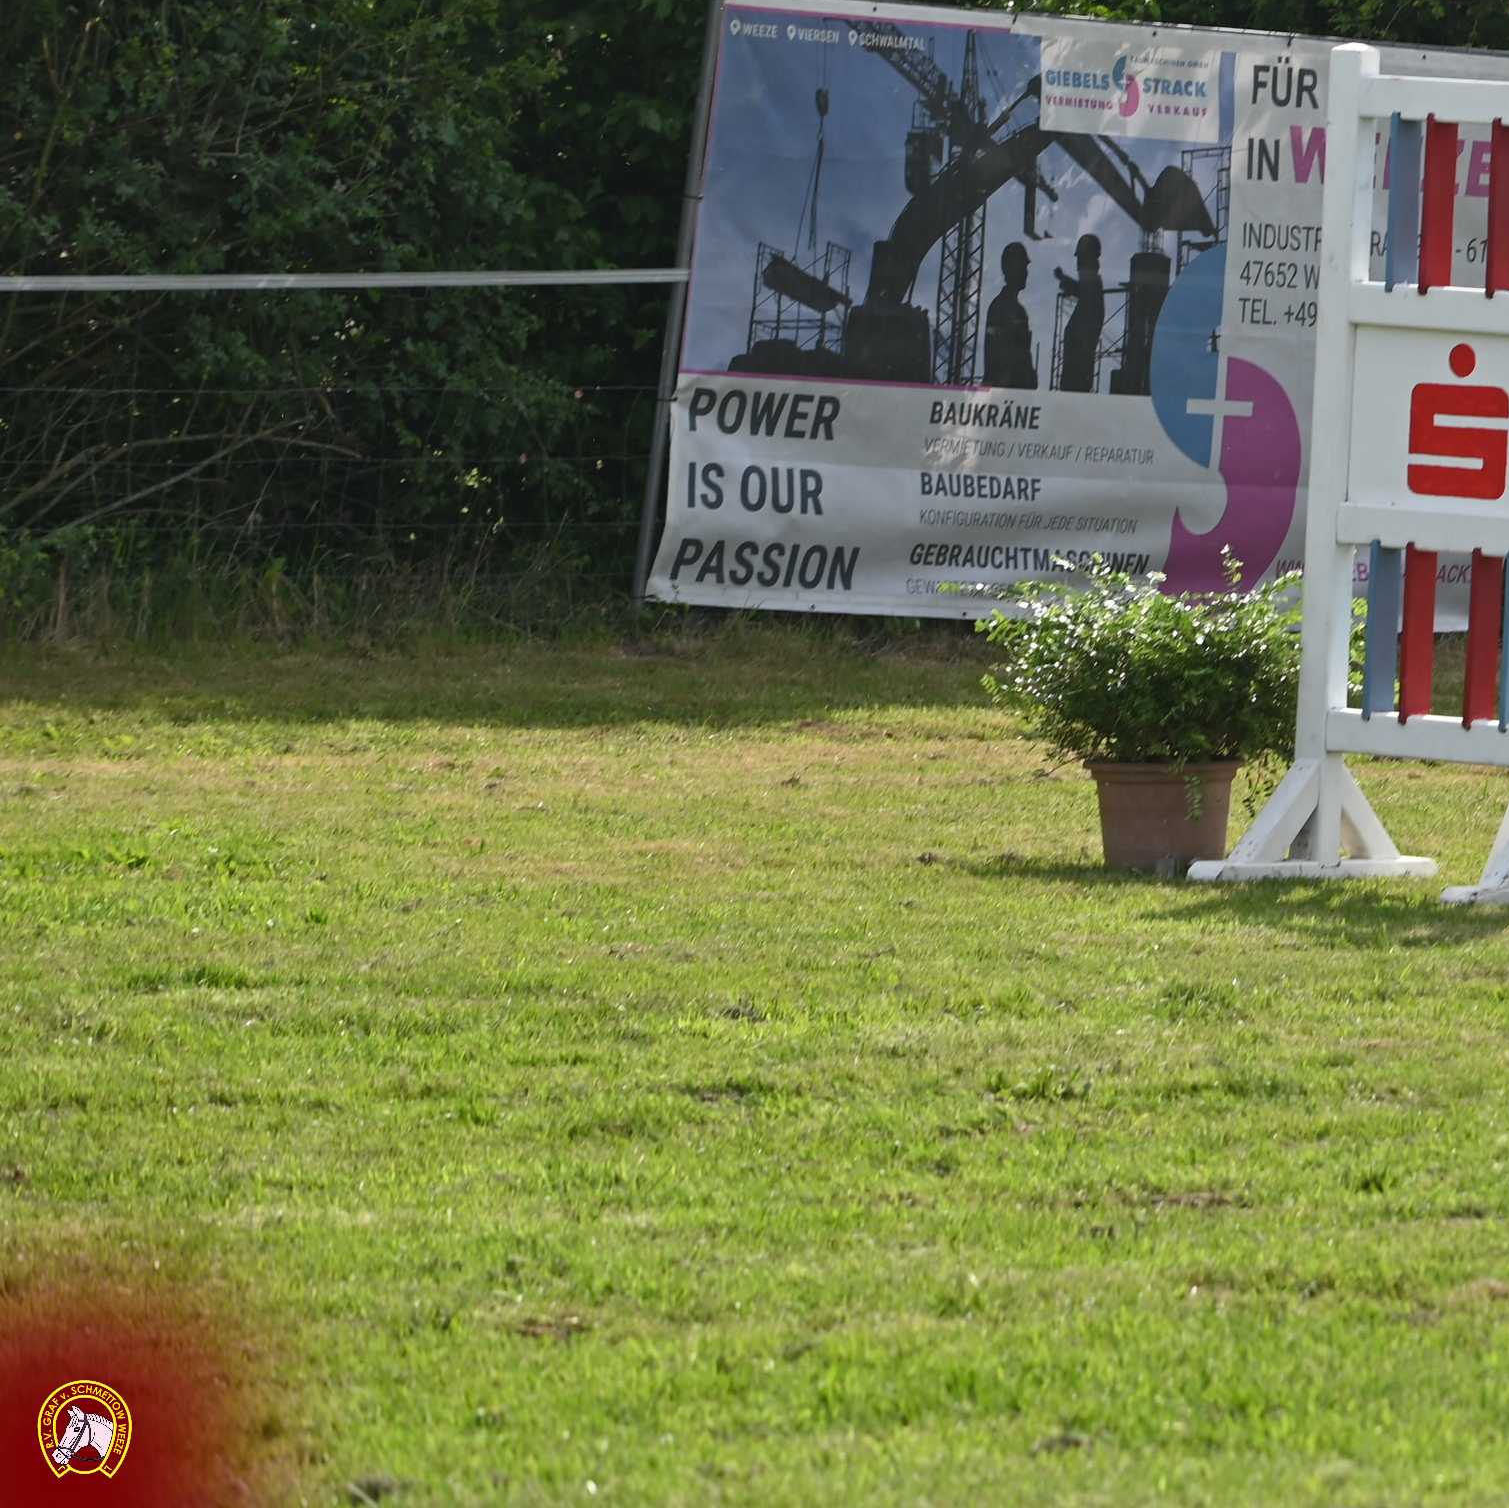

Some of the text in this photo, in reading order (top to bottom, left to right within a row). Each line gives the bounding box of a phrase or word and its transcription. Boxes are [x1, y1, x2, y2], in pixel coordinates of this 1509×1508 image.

[743, 23, 778, 38] WEEZE
[798, 28, 839, 44] VIERSEN
[1046, 70, 1208, 98] GIEBELS STRACK
[1251, 57, 1319, 109] FÜR
[1247, 138, 1280, 182] IN
[1240, 260, 1298, 288] 47652
[1239, 298, 1277, 325] TEL.
[689, 387, 840, 440] POWER
[930, 400, 1041, 430] BAUKRÄNE
[924, 437, 1005, 458] VERMIETUNG
[1017, 442, 1073, 461] VERKAUF
[1085, 447, 1155, 465] REPARATUR
[688, 461, 823, 515] IS OUR
[921, 471, 1041, 501] BAUBEDARF
[919, 509, 1138, 534] KONFIGURATION FÜR JEDE SITUATION
[670, 538, 860, 591] PASSION
